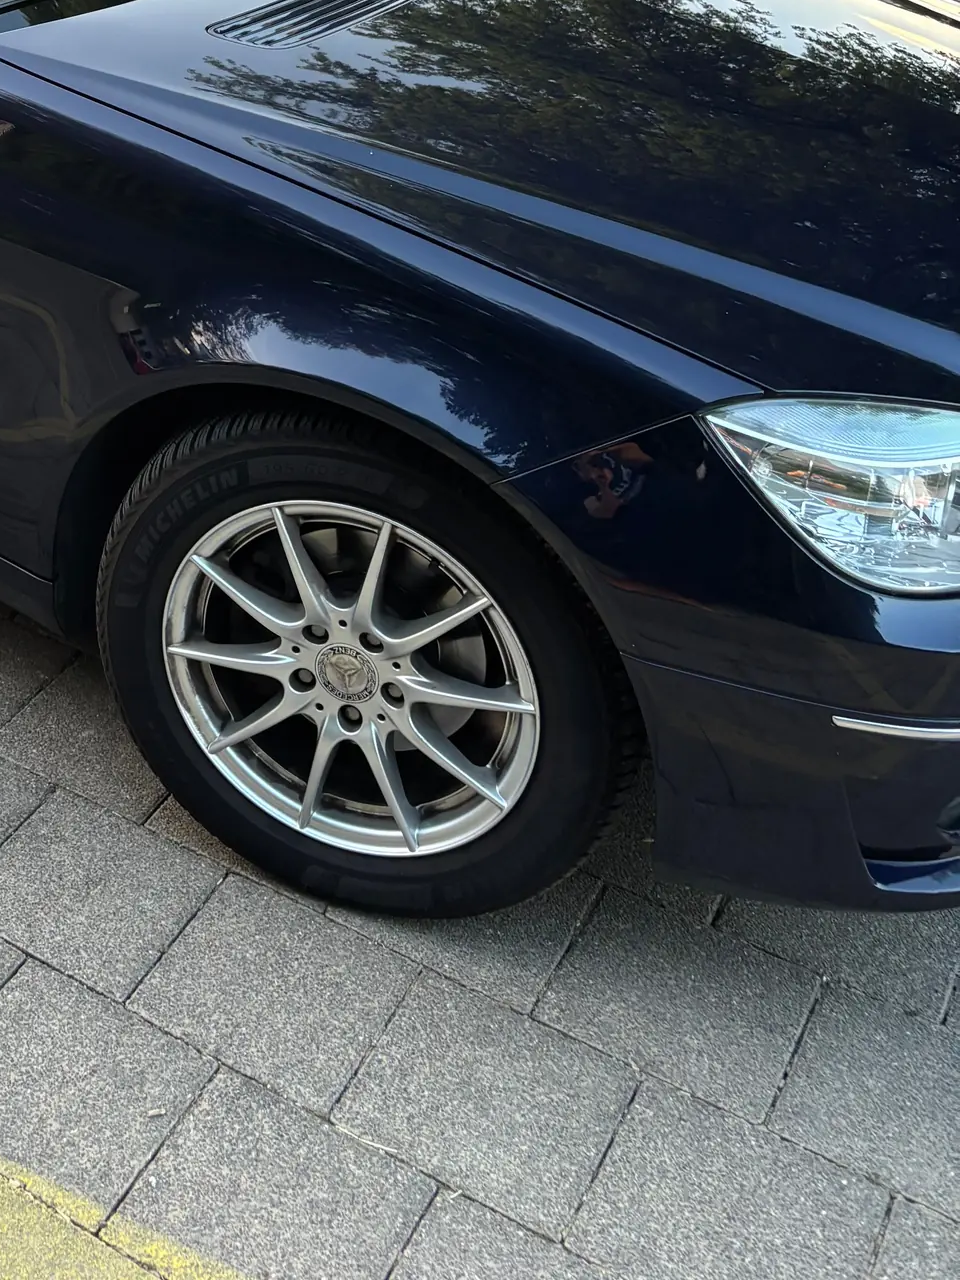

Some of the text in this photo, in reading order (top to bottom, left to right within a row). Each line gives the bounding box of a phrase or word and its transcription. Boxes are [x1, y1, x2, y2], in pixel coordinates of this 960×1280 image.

[134, 468, 239, 563] MICHELIN
[333, 647, 357, 657] BENZ
[326, 684, 370, 701] MERCEDES
